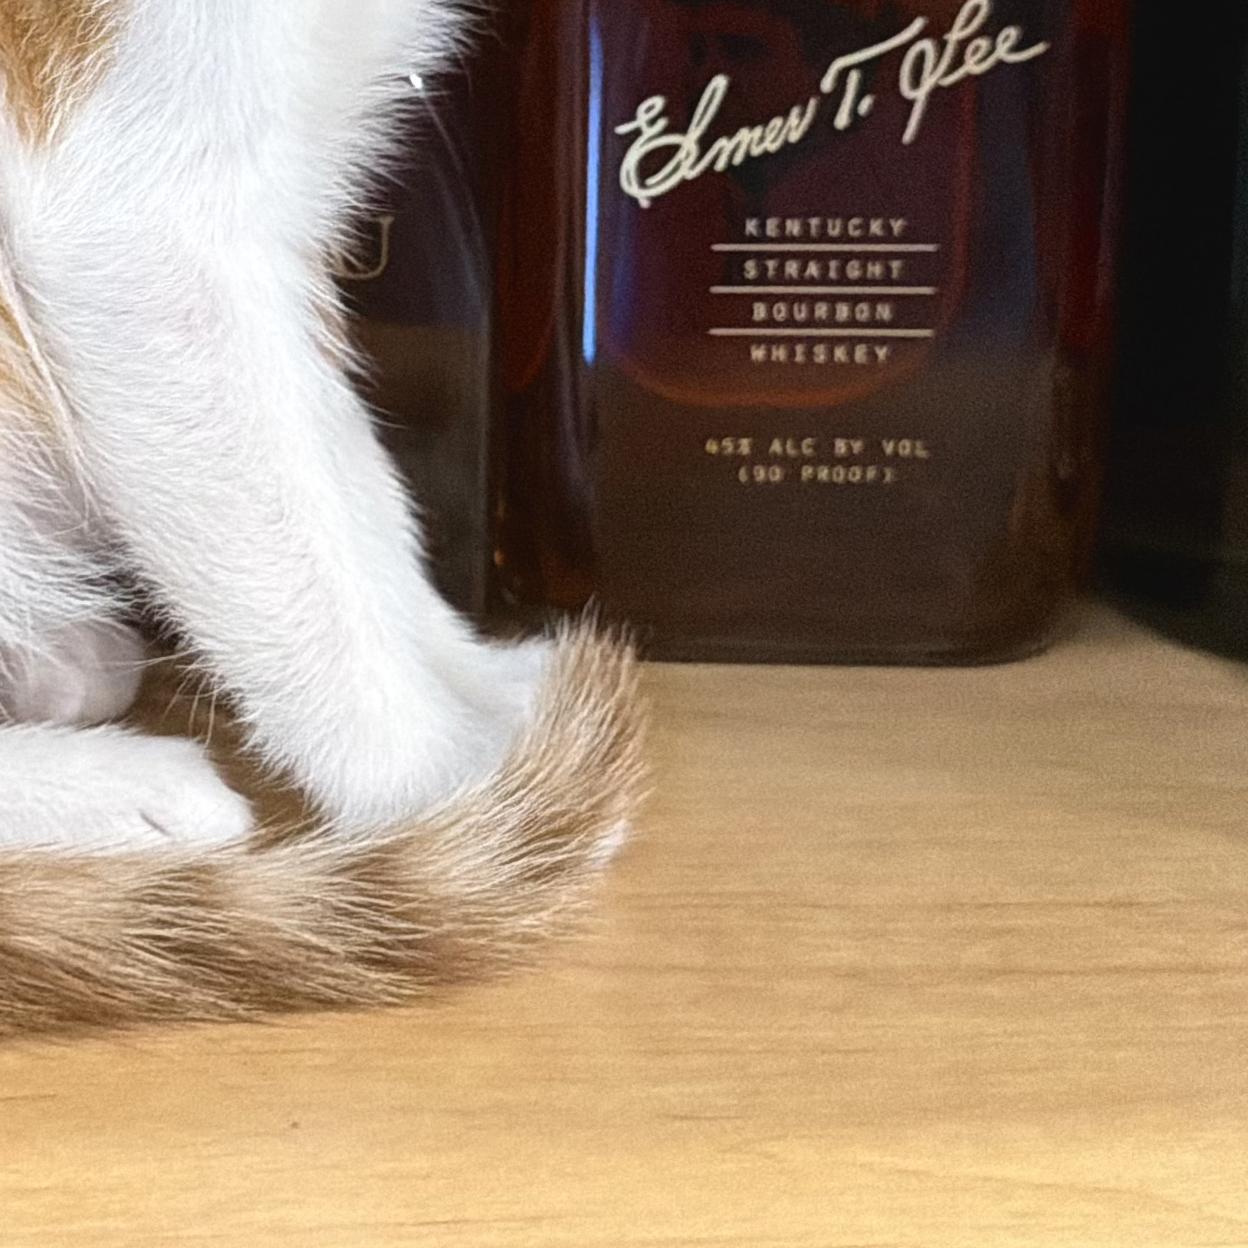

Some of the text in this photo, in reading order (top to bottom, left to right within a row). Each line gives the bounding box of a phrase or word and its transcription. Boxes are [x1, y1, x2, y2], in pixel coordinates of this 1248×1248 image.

[615, 74, 820, 209] Elmer
[744, 217, 908, 238] KENTUCKY
[743, 259, 904, 280] STRAIGHT
[752, 302, 894, 322] BOURBON
[750, 344, 889, 364] WHISKEY
[769, 438, 815, 457] ALC
[881, 438, 930, 458] VOL
